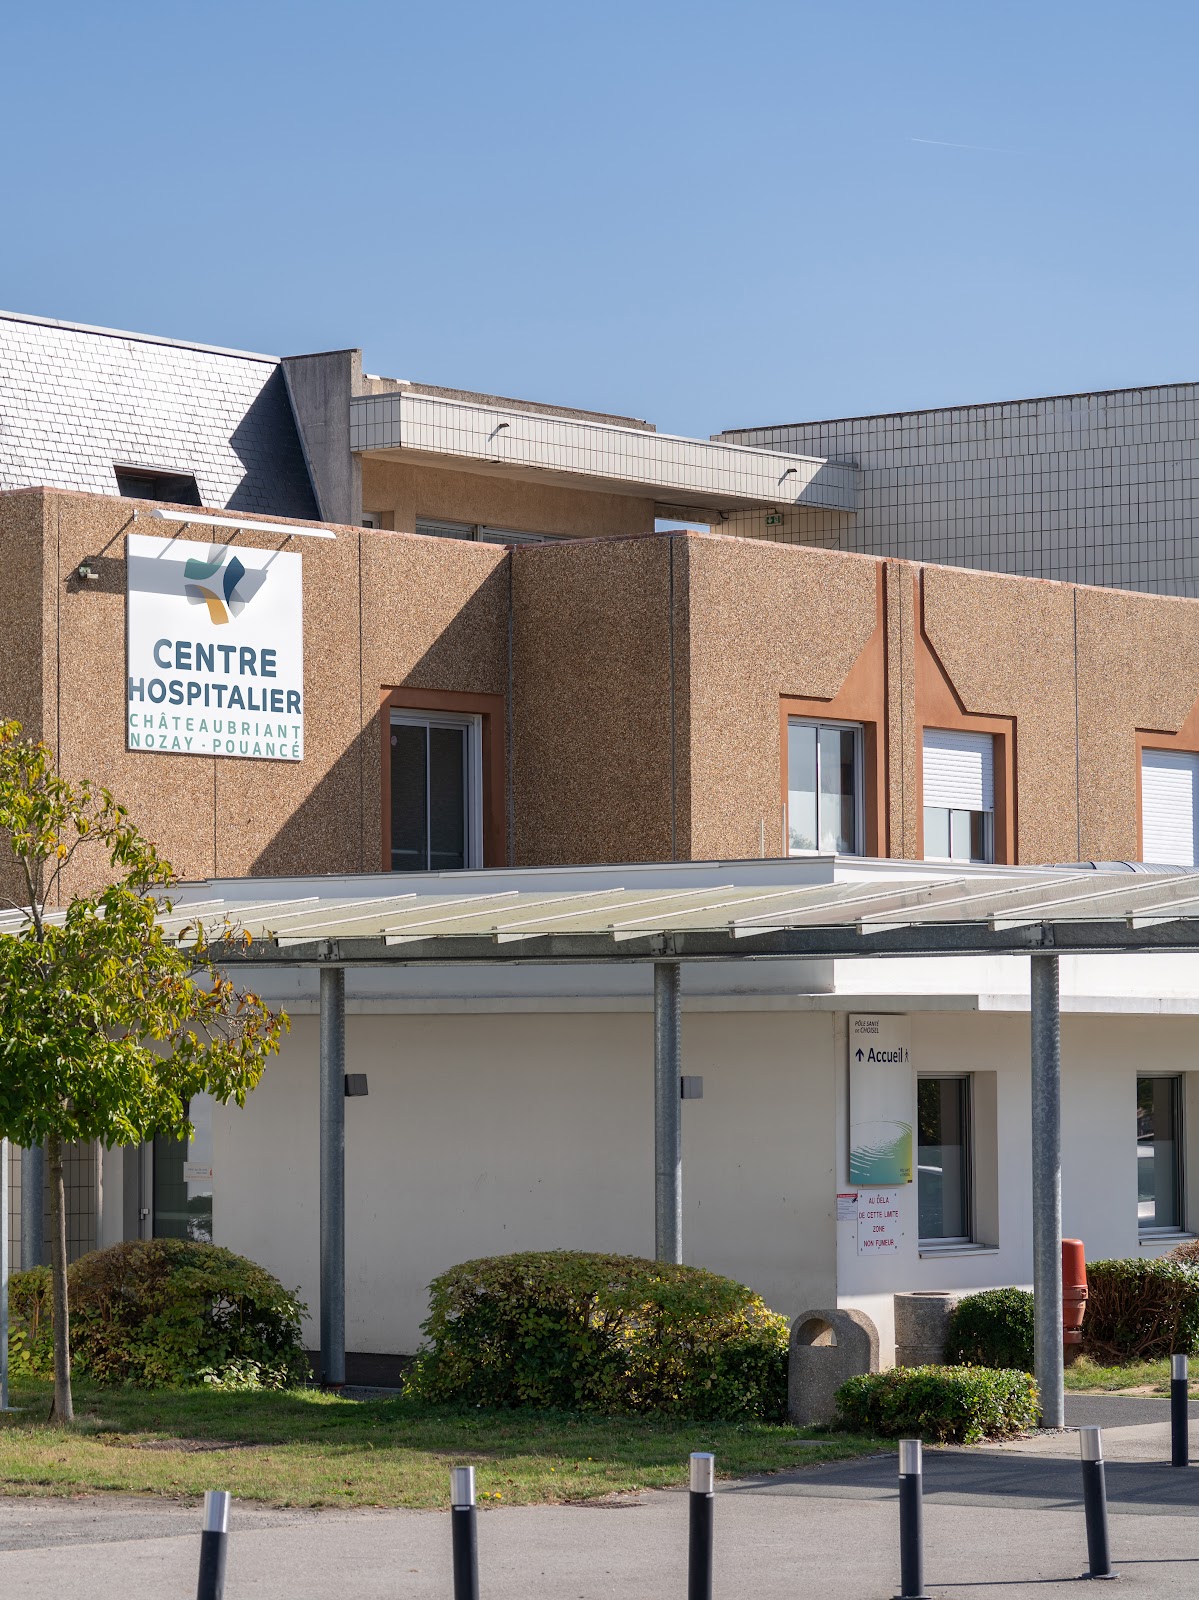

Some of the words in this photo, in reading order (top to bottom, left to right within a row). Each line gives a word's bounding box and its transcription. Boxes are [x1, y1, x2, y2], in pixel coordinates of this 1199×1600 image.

[153, 638, 276, 678] CENTRE
[128, 676, 301, 714] HOSPITALIER
[129, 712, 300, 739] CHÂTEAUBRIANT
[130, 732, 193, 751] NOZAY
[213, 738, 300, 758] POUANCÉ
[867, 1047, 903, 1062] Accueil
